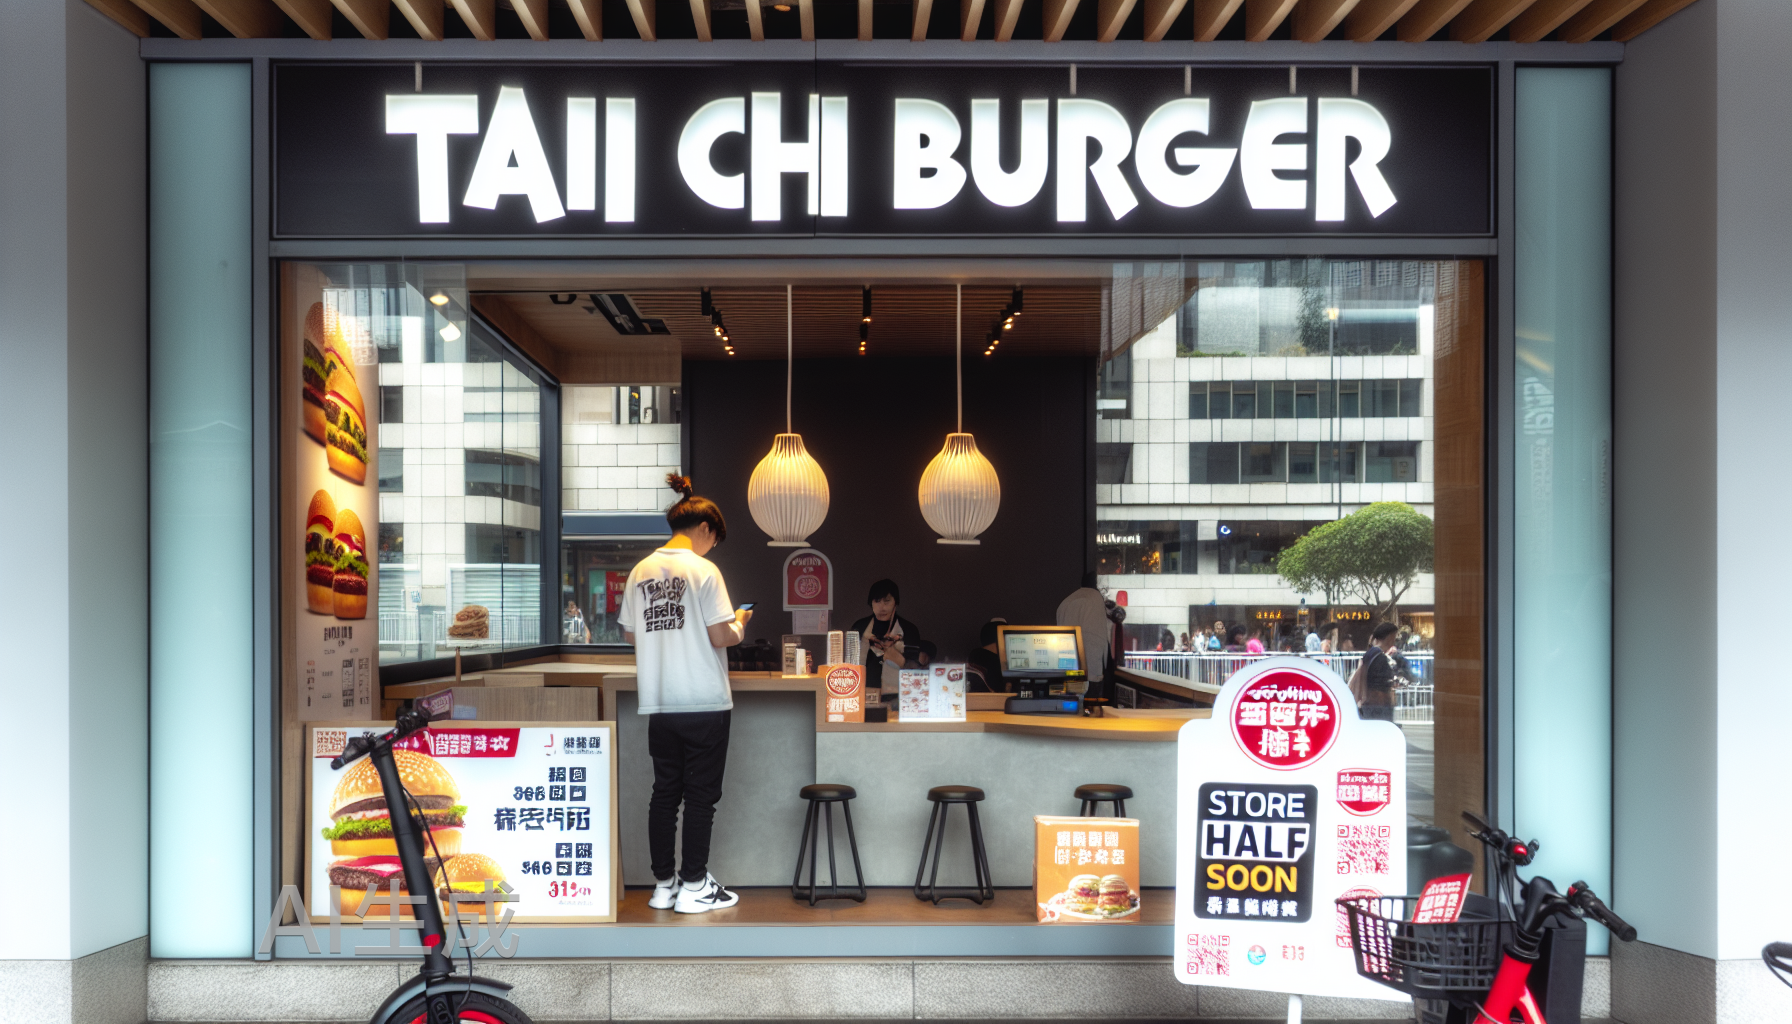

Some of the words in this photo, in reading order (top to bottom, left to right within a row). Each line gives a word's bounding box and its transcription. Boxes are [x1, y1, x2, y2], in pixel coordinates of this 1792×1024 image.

[893, 96, 1399, 223] BURGER
[1208, 789, 1306, 819] STORE
[1205, 823, 1308, 860] HALF
[1206, 863, 1298, 894] SOON
